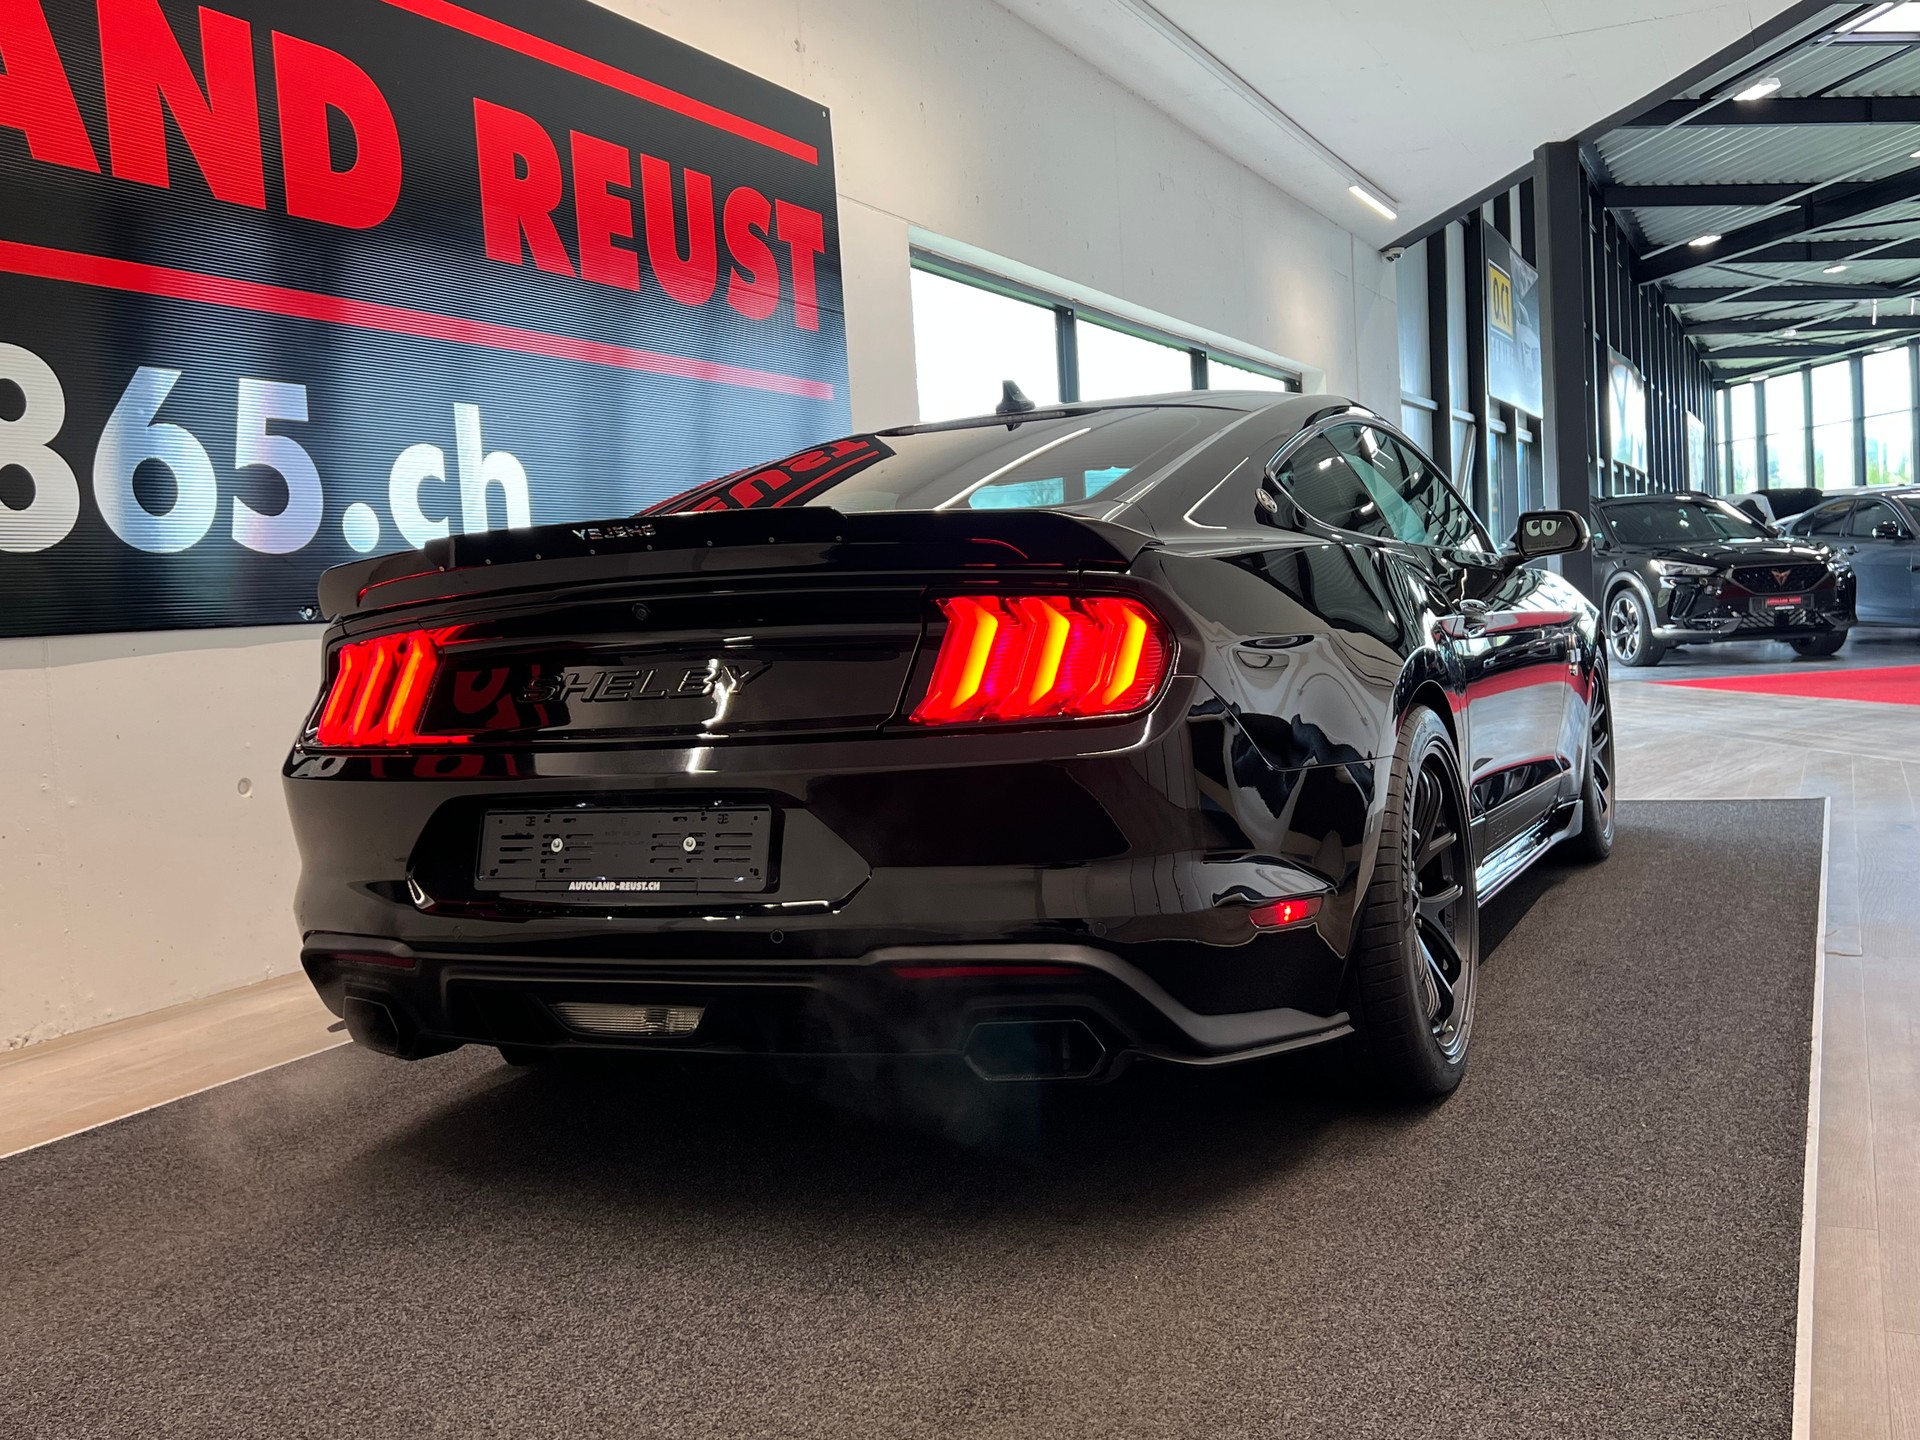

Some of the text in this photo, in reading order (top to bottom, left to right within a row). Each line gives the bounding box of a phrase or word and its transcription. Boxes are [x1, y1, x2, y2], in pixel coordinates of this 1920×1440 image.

[473, 97, 825, 331] REUST
[0, 341, 531, 555] 865.ch
[518, 660, 773, 703] SHELBY
[569, 881, 660, 891] AUTOLAND-REUST.CH
[1402, 770, 1412, 892] MICHELIN
